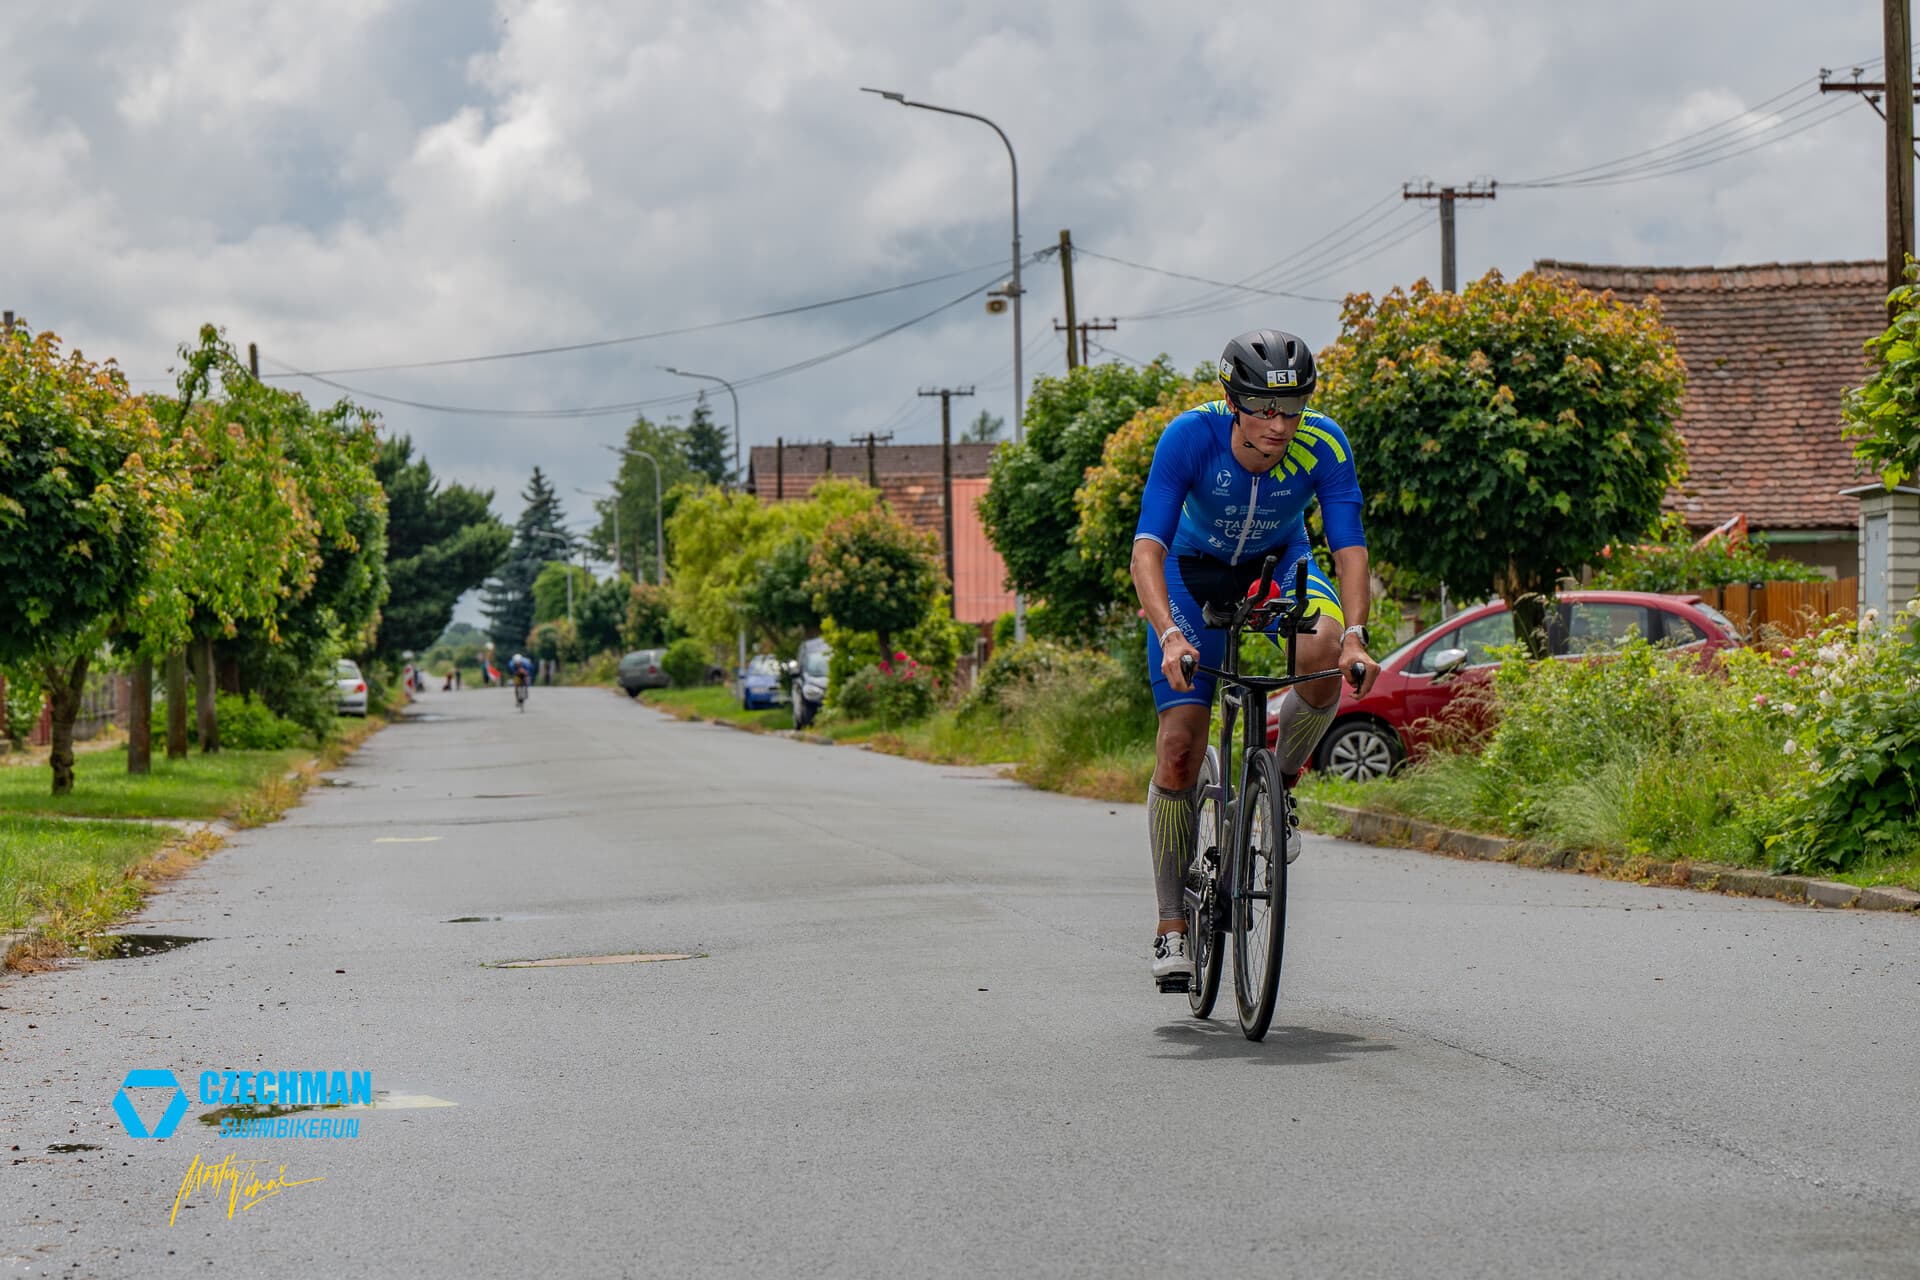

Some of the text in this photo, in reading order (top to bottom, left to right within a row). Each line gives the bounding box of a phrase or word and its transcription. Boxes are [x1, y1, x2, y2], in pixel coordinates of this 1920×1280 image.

[1270, 489, 1292, 497] ATEX
[1214, 518, 1281, 530] STADNIK
[1224, 528, 1264, 540] CZE
